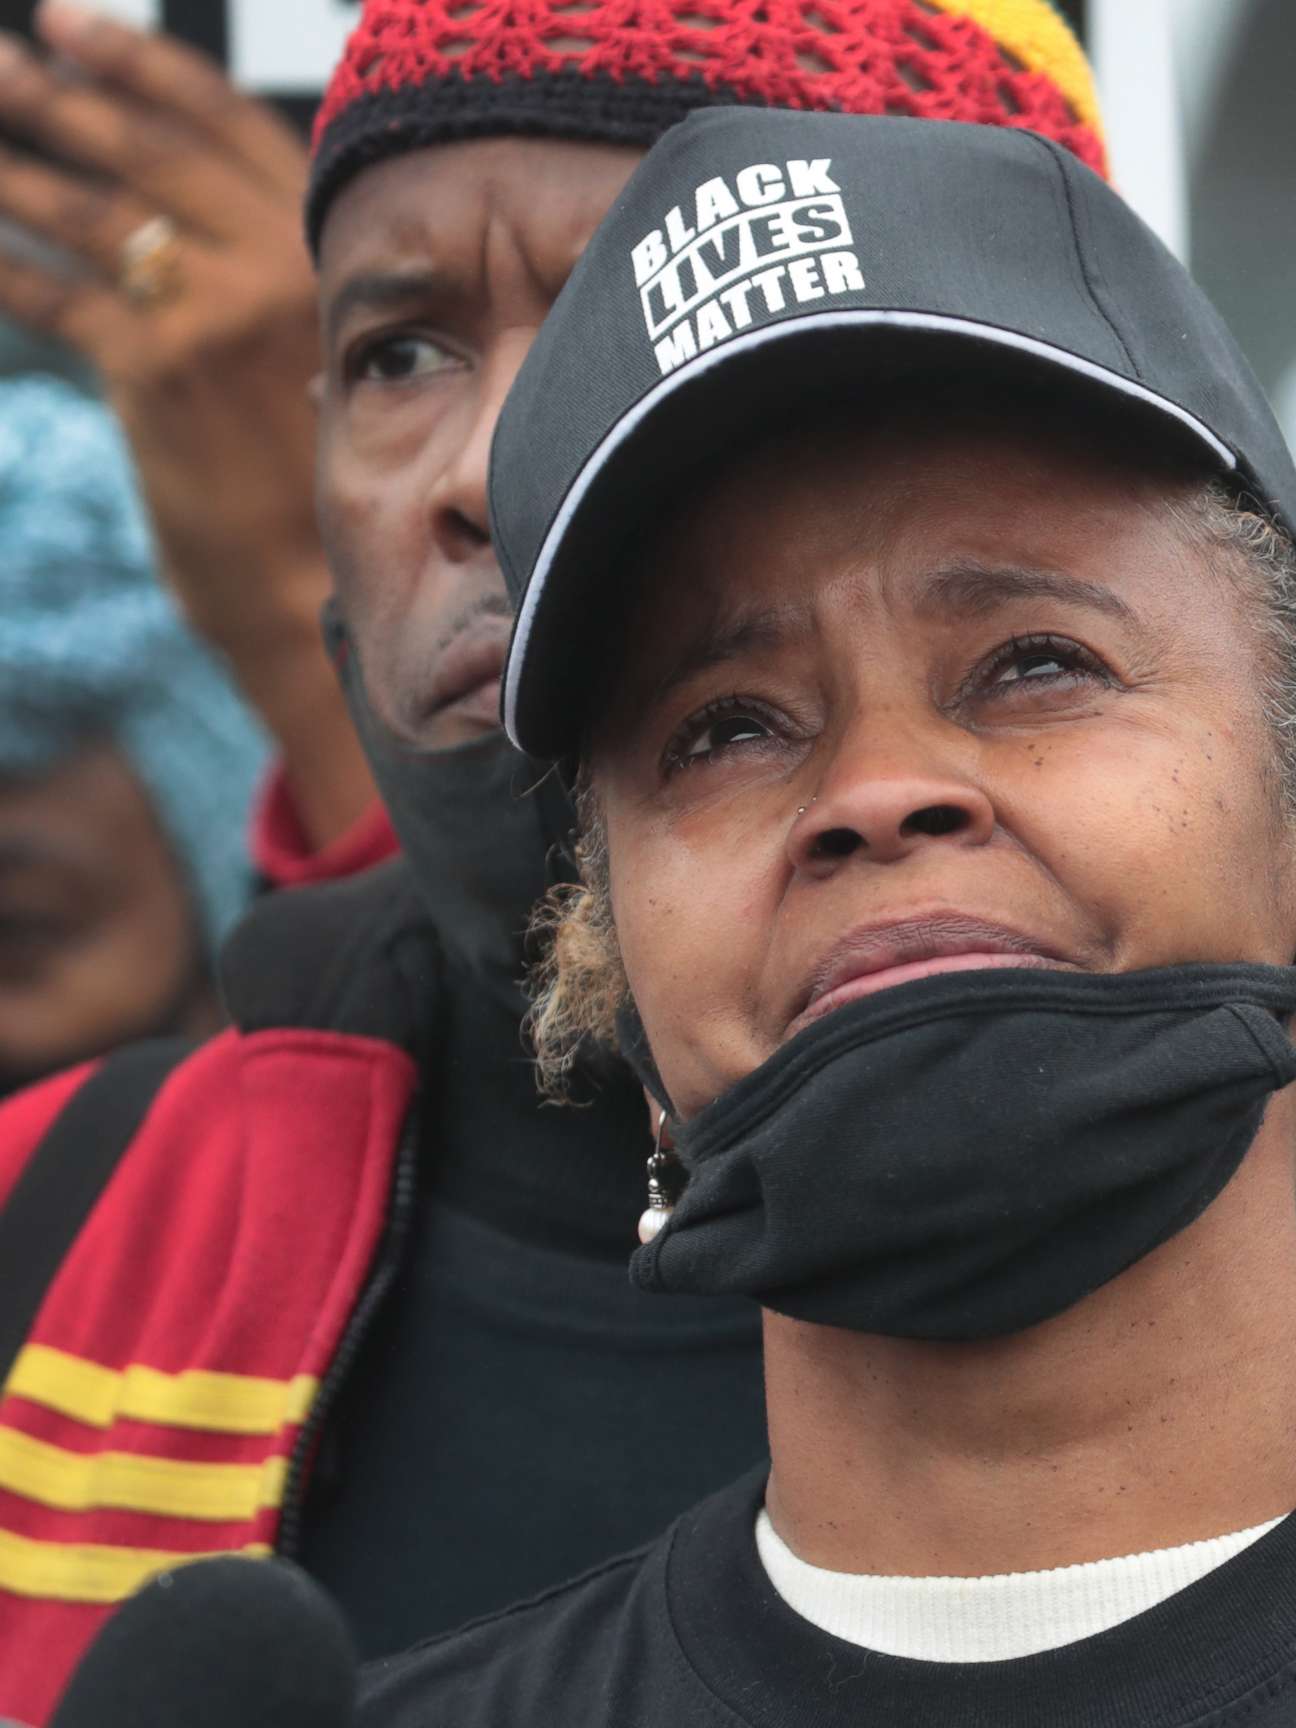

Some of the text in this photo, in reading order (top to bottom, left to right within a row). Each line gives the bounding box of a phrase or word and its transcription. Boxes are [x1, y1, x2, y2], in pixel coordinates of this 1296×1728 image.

[631, 159, 841, 287] BLACK
[645, 202, 844, 332] LIVES
[654, 251, 865, 375] MATTER
